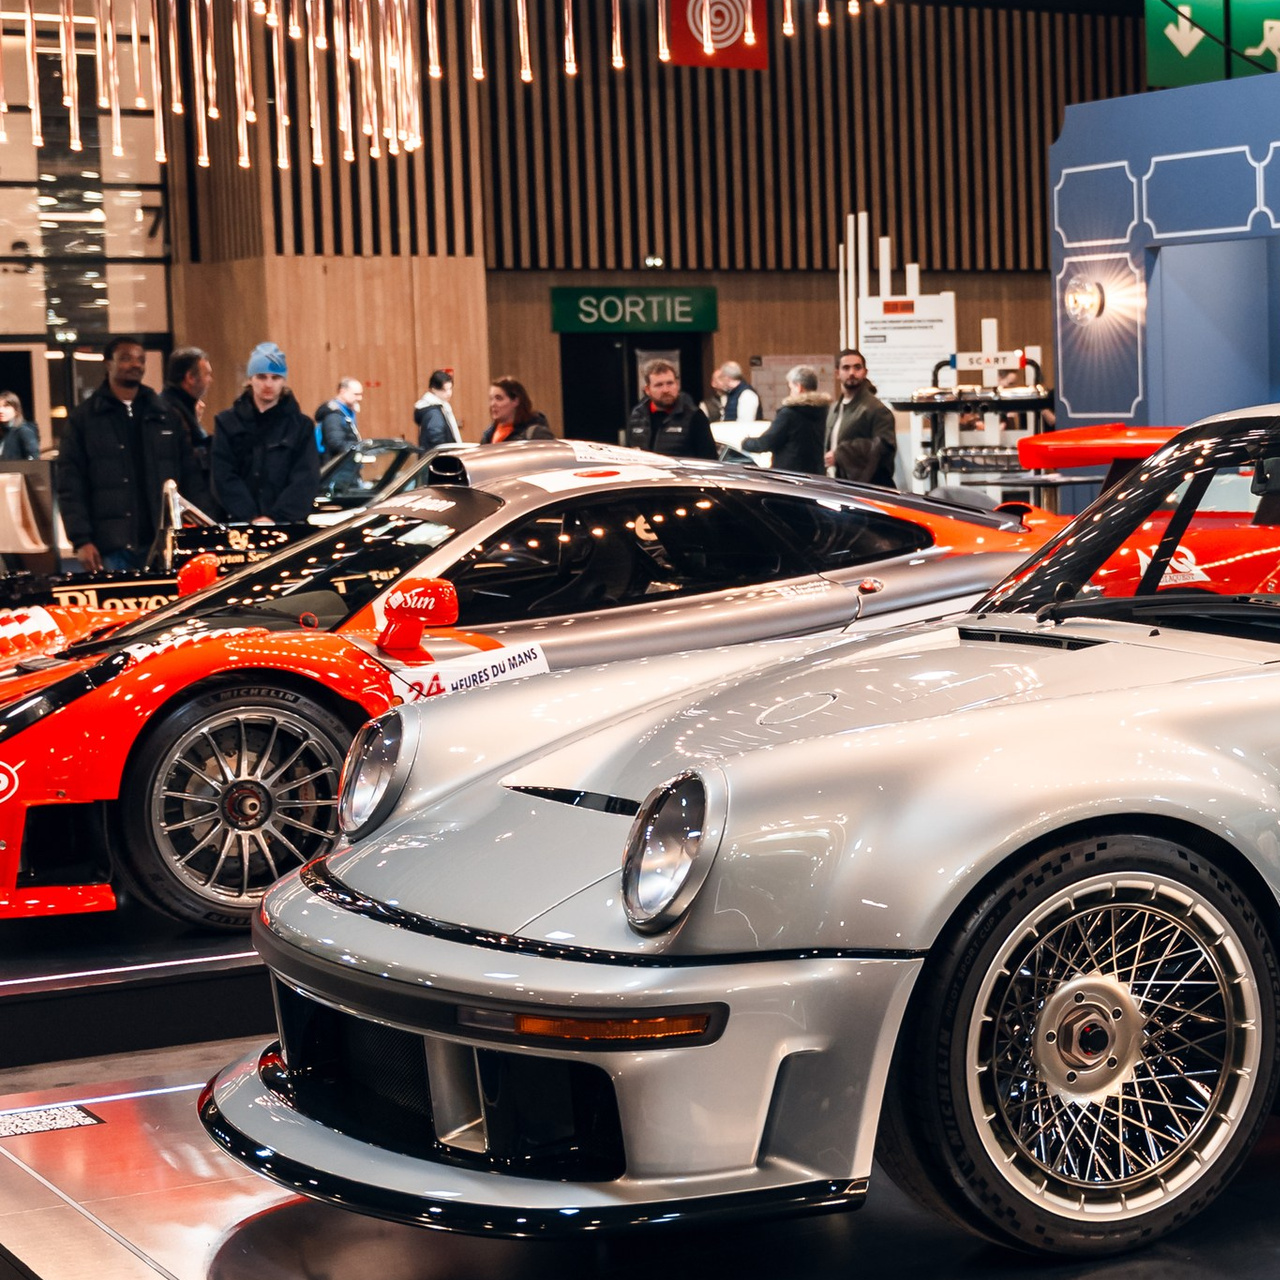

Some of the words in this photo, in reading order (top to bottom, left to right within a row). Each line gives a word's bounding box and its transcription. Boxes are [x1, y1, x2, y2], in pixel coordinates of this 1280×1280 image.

[578, 296, 693, 323] SORTIE
[968, 356, 1008, 366] SCART
[403, 591, 435, 610] Sun
[409, 672, 446, 701] 24
[451, 671, 490, 692] HEURES
[492, 662, 507, 678] DU
[509, 647, 538, 670] MANS
[220, 688, 296, 702] MICHELIN
[938, 1028, 963, 1146] MICHELIN
